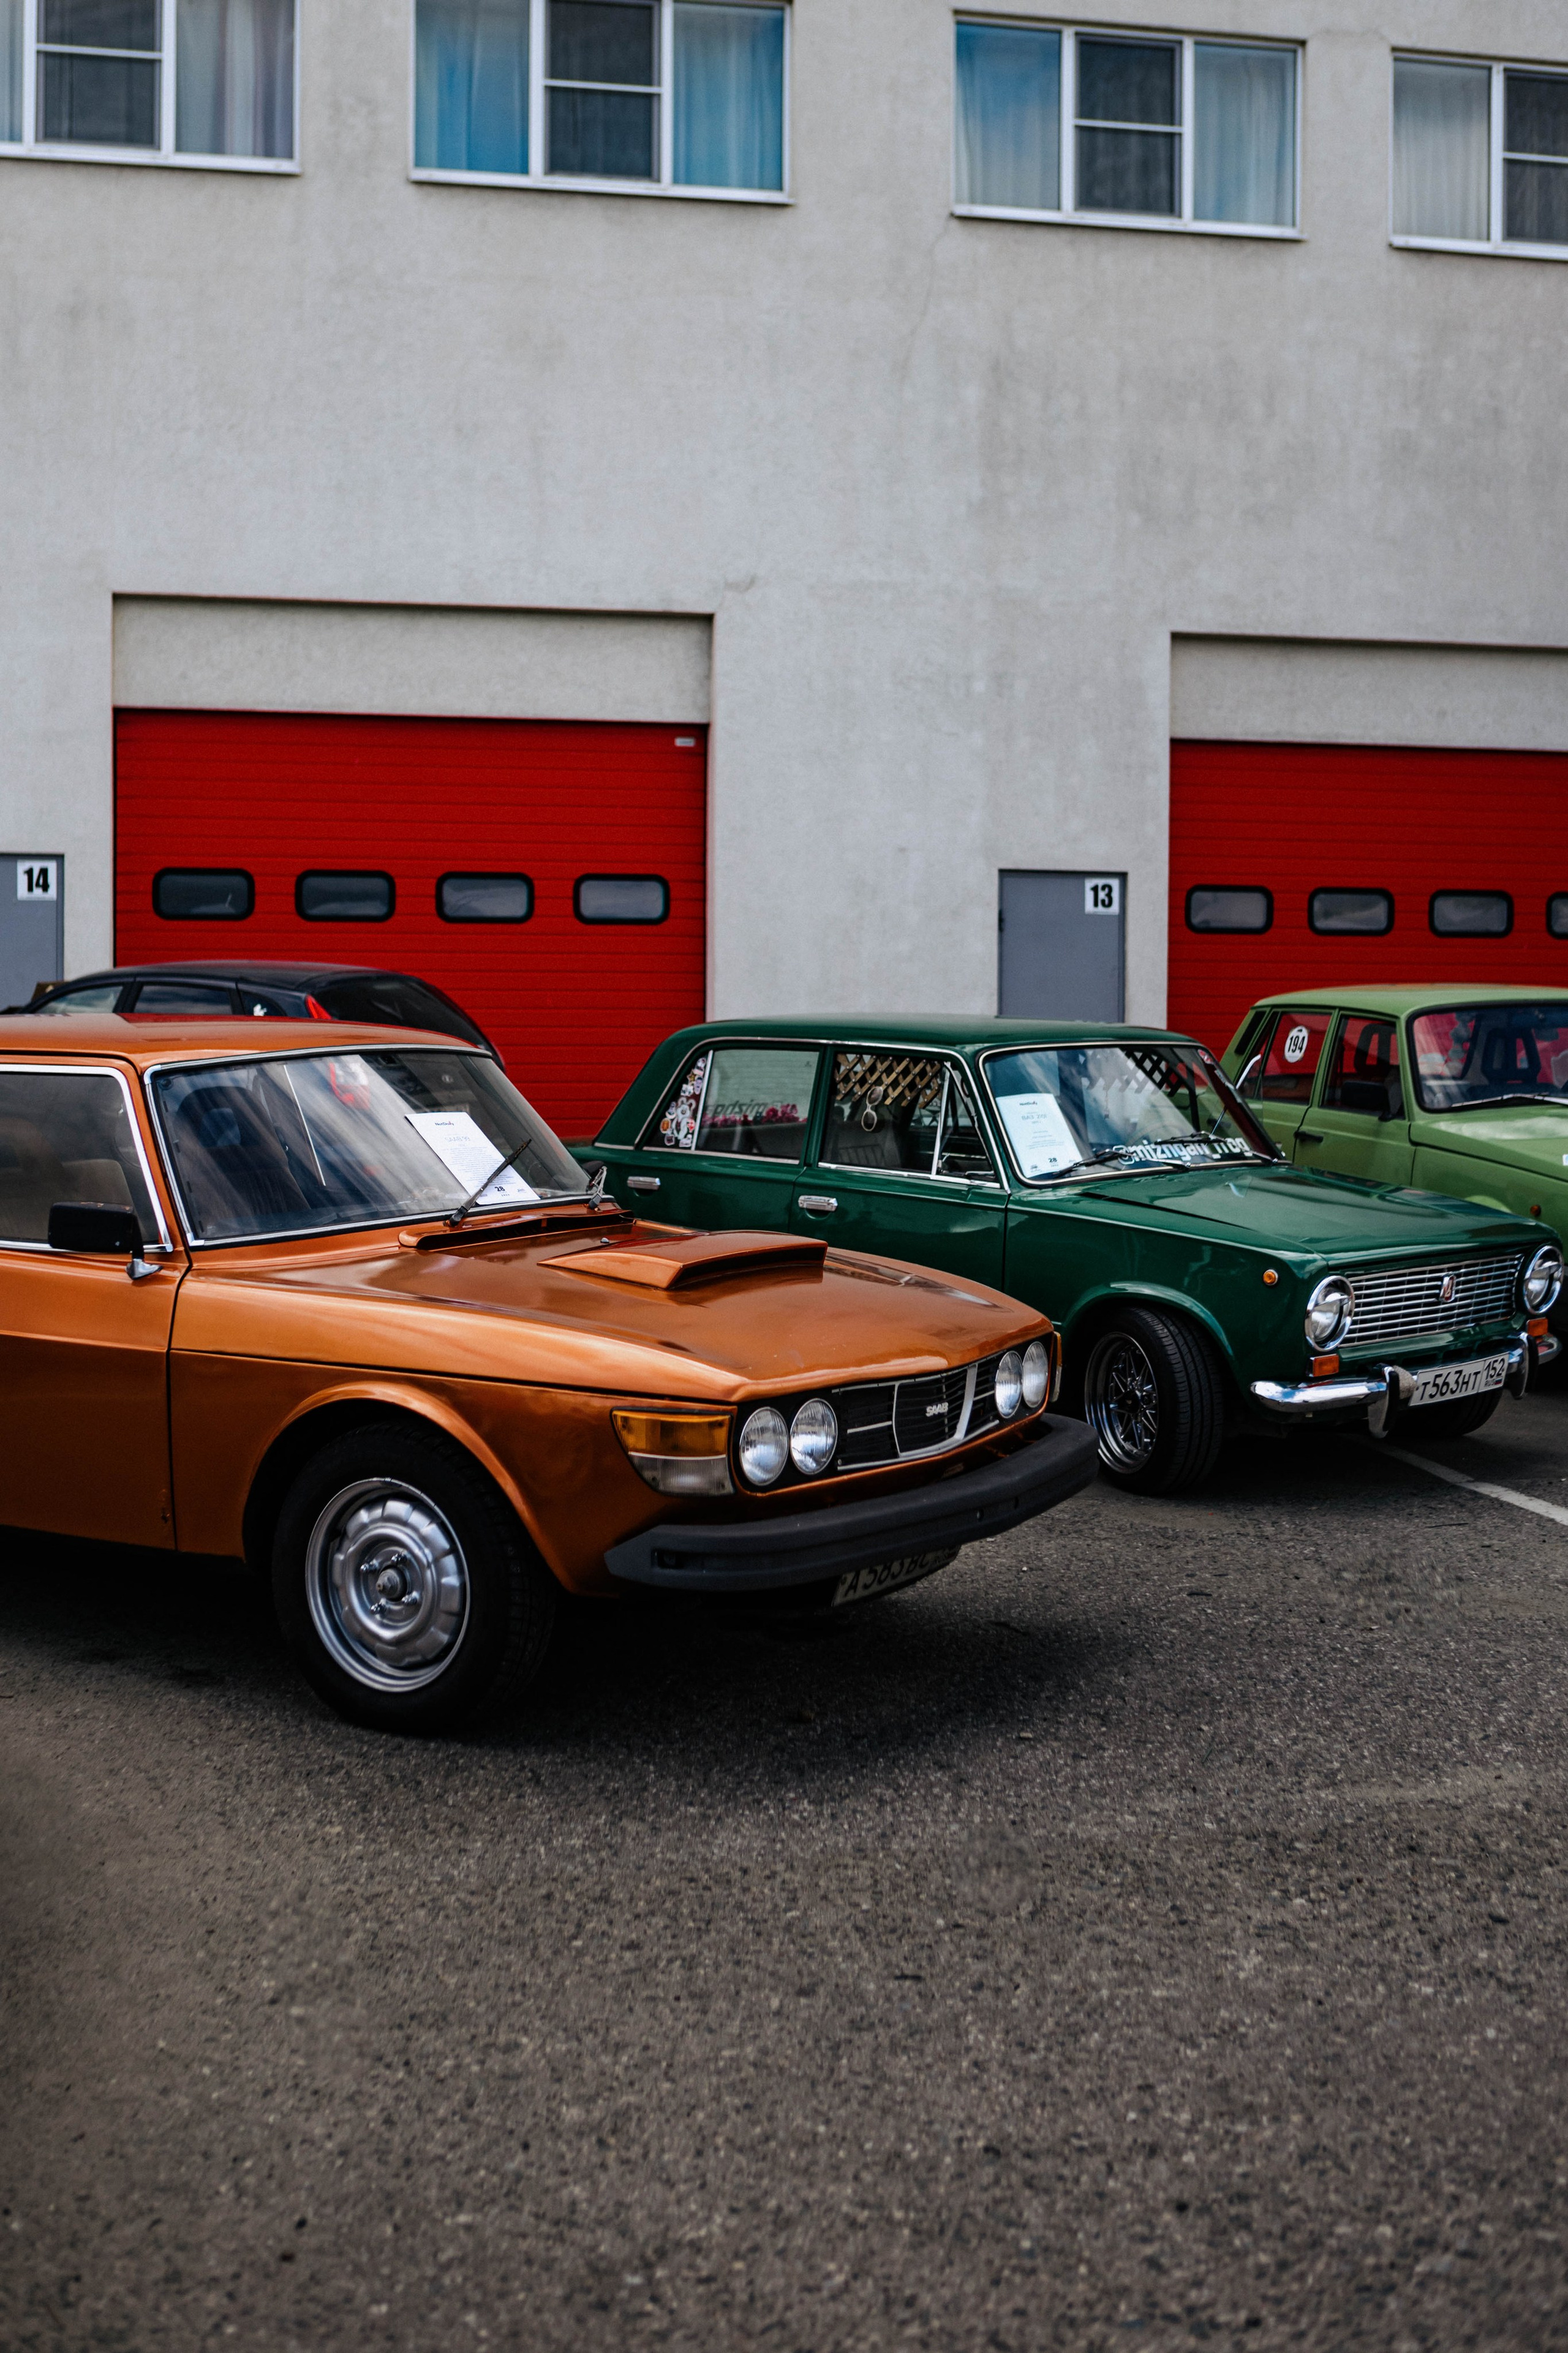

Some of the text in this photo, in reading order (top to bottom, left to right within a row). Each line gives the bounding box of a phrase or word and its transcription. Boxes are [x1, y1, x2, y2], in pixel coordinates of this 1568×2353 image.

[23, 867, 50, 893] 14
[1090, 884, 1113, 908] 13
[1287, 1035, 1305, 1053] 194
[1419, 1358, 1506, 1401] Т563НТ 152
[925, 1402, 949, 1417] SAAB
